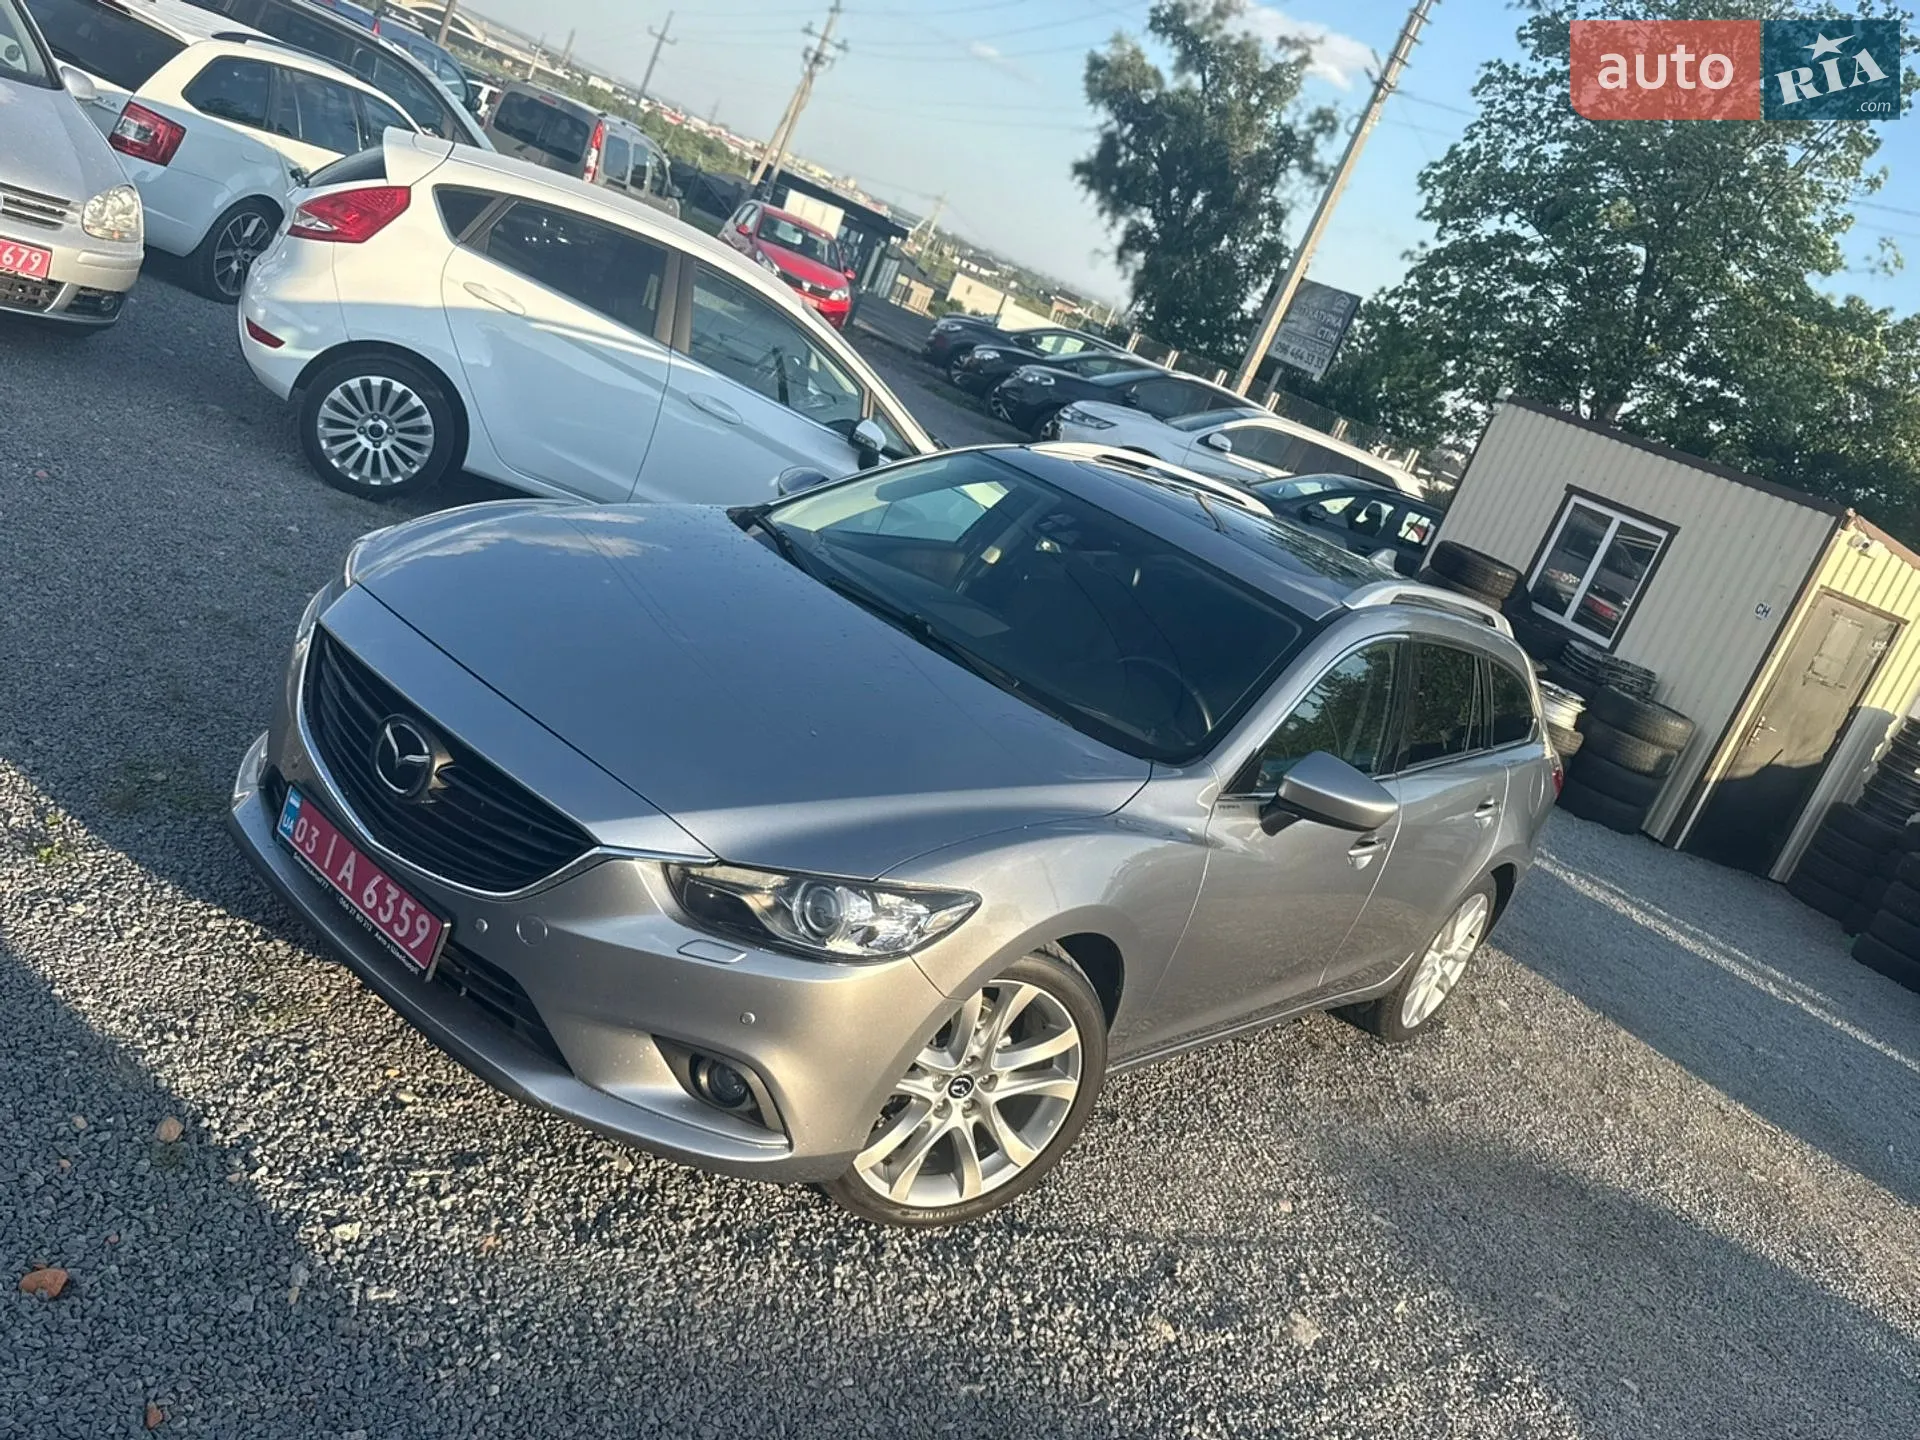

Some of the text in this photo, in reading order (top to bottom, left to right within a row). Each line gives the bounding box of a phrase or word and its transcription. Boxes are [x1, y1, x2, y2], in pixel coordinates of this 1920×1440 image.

[0, 245, 43, 272] 679
[283, 814, 294, 833] UA
[294, 816, 321, 854] 03
[324, 833, 357, 892] IA
[362, 874, 431, 950] 6359
